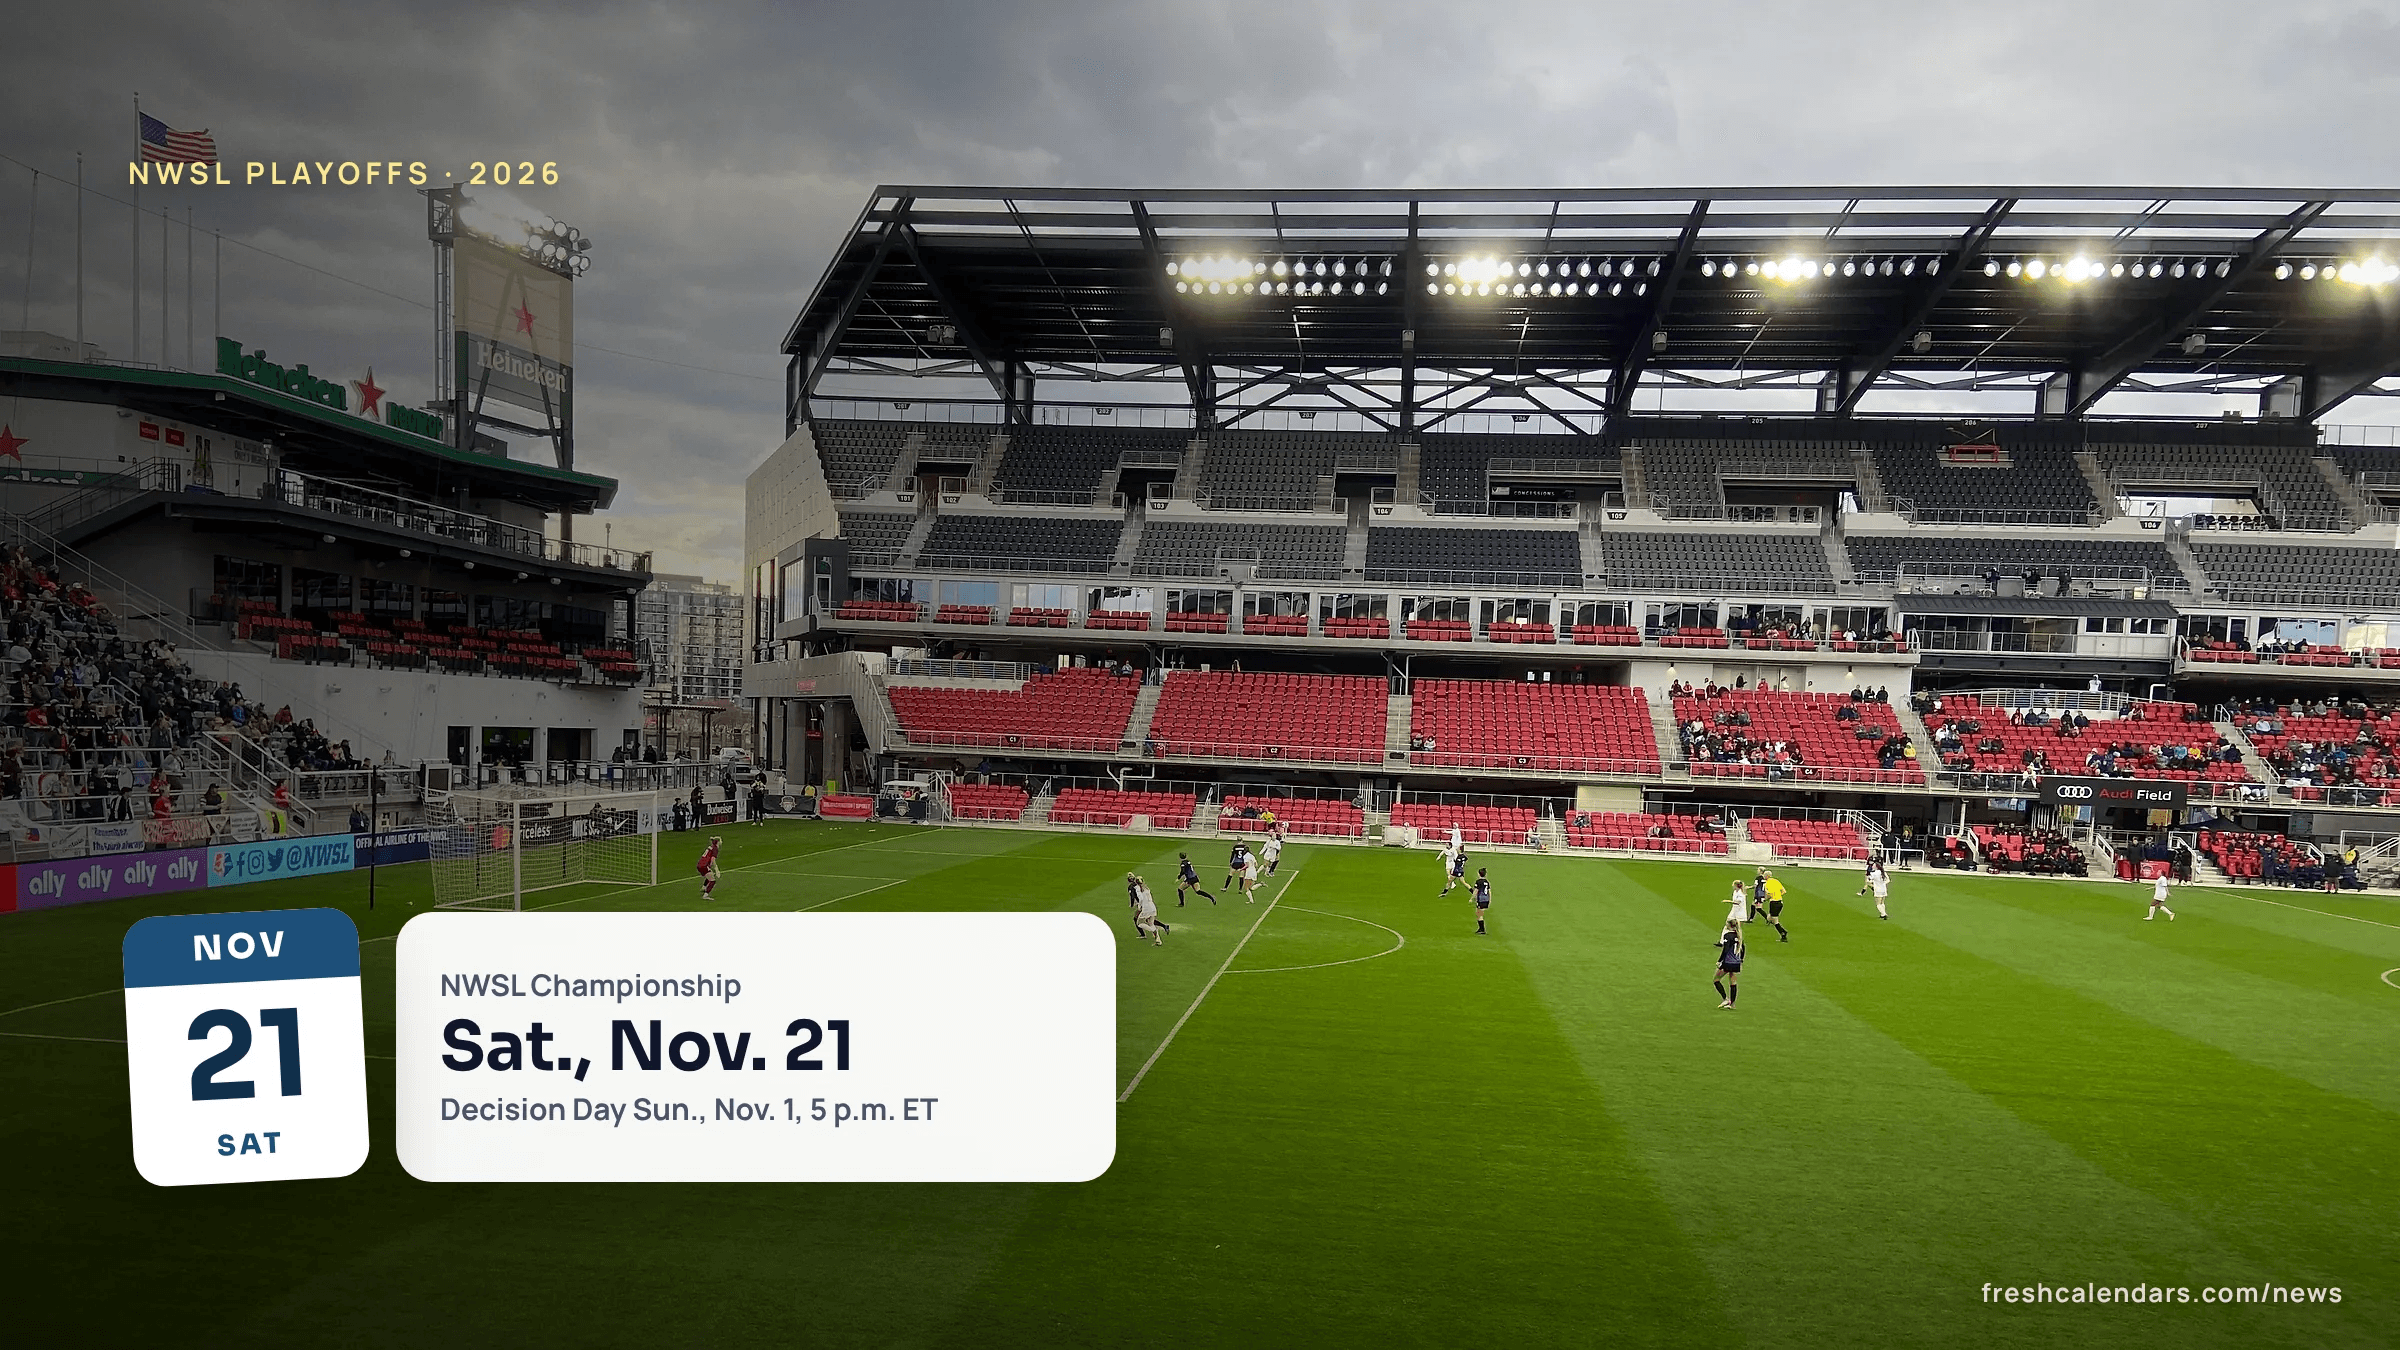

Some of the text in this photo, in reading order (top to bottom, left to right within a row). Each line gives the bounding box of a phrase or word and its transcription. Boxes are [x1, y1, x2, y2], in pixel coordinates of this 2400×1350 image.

[216, 336, 348, 411] Heineken
[477, 341, 567, 393] Heineken
[2099, 788, 2172, 801] Audi Field
[706, 803, 734, 815] Budweiser
[384, 834, 408, 846] AIRLINE
[408, 832, 416, 843] OF
[417, 832, 430, 842] THE
[520, 823, 551, 840] riceless
[287, 842, 350, 871] @NWSL
[28, 856, 199, 898] ally ally ally ally
